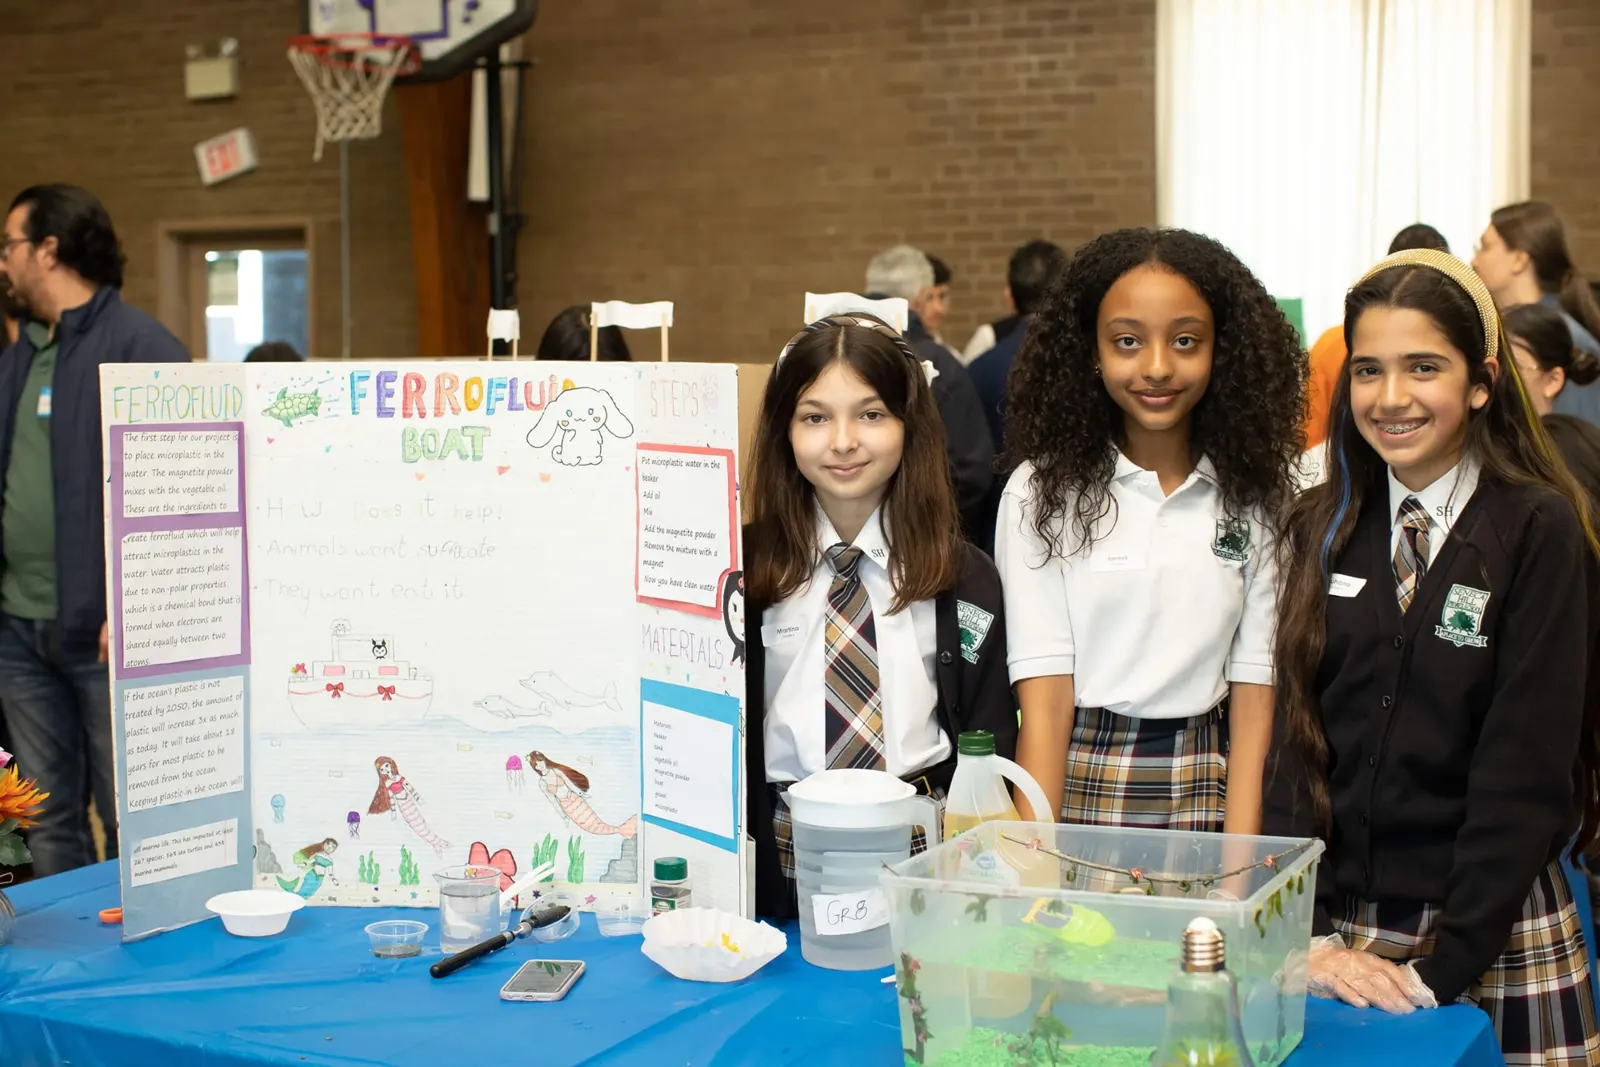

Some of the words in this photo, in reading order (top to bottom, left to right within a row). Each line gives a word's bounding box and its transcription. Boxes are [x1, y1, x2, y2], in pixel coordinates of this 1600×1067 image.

[114, 384, 242, 423] FERROFLUID
[650, 380, 698, 417] STEPS
[125, 433, 138, 442] The
[141, 432, 157, 441] first
[160, 434, 176, 444] step
[178, 432, 188, 441] for
[205, 433, 230, 444] project
[402, 425, 491, 462] BOAT
[124, 451, 132, 460] to
[135, 451, 154, 462] place
[158, 450, 201, 460] microplastic
[204, 450, 211, 458] in
[641, 457, 651, 465] Put
[652, 456, 683, 468] microplastic
[685, 459, 701, 468] water
[704, 460, 710, 468] in
[711, 460, 720, 469] the
[152, 468, 166, 477] The
[168, 467, 205, 479] magnetite
[207, 467, 234, 478] powder
[124, 487, 146, 495] mixes
[148, 485, 166, 494] with
[168, 485, 180, 494] the
[182, 484, 215, 496] vegetable
[643, 490, 653, 499] Add
[125, 505, 145, 514] These
[163, 504, 175, 512] the
[178, 502, 217, 513] ingredients
[1436, 506, 1453, 517] SH
[150, 531, 184, 541] ferrofluid
[187, 529, 208, 539] which
[210, 528, 222, 537] will
[225, 528, 240, 538] help
[644, 525, 655, 533] Add
[666, 528, 693, 538] magnetite
[695, 529, 716, 540] powder
[124, 550, 150, 560] attract
[154, 546, 200, 560] microplastics
[203, 547, 210, 555] in
[212, 545, 224, 554] the
[267, 535, 346, 556] Animals
[644, 541, 665, 551] Remove
[666, 544, 674, 552] the
[676, 544, 697, 555] mixture
[699, 547, 712, 556] with
[871, 548, 885, 559] SH
[151, 567, 174, 576] Water
[176, 565, 205, 575] attracts
[207, 562, 230, 574] plastic
[643, 559, 664, 569] magnet
[124, 587, 138, 597] due
[141, 586, 149, 595] to
[151, 583, 188, 595] non-polar
[658, 578, 668, 587] you
[670, 578, 683, 587] have
[684, 580, 698, 589] clean
[699, 582, 715, 592] water
[265, 578, 310, 618] They
[391, 577, 434, 600] eat
[443, 577, 465, 600] it
[1453, 589, 1484, 600] SENECA
[125, 604, 147, 614] which
[150, 603, 156, 612] is
[164, 600, 196, 612] chemical
[198, 598, 216, 607] bond
[218, 596, 233, 605] that
[236, 595, 241, 604] is
[125, 621, 152, 632] formed
[155, 619, 175, 629] when
[177, 616, 209, 627] electrons
[125, 639, 150, 650] shared
[153, 635, 178, 648] equally
[180, 633, 210, 644] between
[212, 631, 226, 639] two
[642, 623, 724, 670] MATERIALS
[132, 692, 145, 701] the
[147, 687, 172, 699] ocean's
[174, 684, 198, 696] plastic
[200, 681, 205, 690] is
[208, 679, 220, 688] not
[125, 710, 152, 720] treated
[155, 706, 164, 717] by
[192, 698, 203, 708] the
[206, 694, 233, 706] amount
[235, 690, 243, 700] of
[126, 725, 149, 740] plastic
[152, 722, 165, 732] will
[167, 718, 196, 730] increase
[220, 709, 239, 720] much
[126, 748, 135, 756] as
[162, 739, 168, 748] It
[170, 736, 183, 748] will
[185, 734, 200, 745] take
[203, 730, 223, 741] about
[128, 764, 146, 775] years
[148, 759, 160, 769] for
[162, 755, 180, 766] most
[182, 750, 205, 764] plastic
[207, 748, 215, 757] to
[217, 746, 225, 755] be
[128, 776, 159, 791] removed
[162, 772, 180, 785] from
[182, 768, 193, 779] the
[129, 795, 158, 808] Keeping
[160, 789, 183, 804] plastic
[186, 786, 192, 795] in
[195, 782, 206, 793] the
[208, 781, 228, 791] ocean
[230, 775, 244, 786] will
